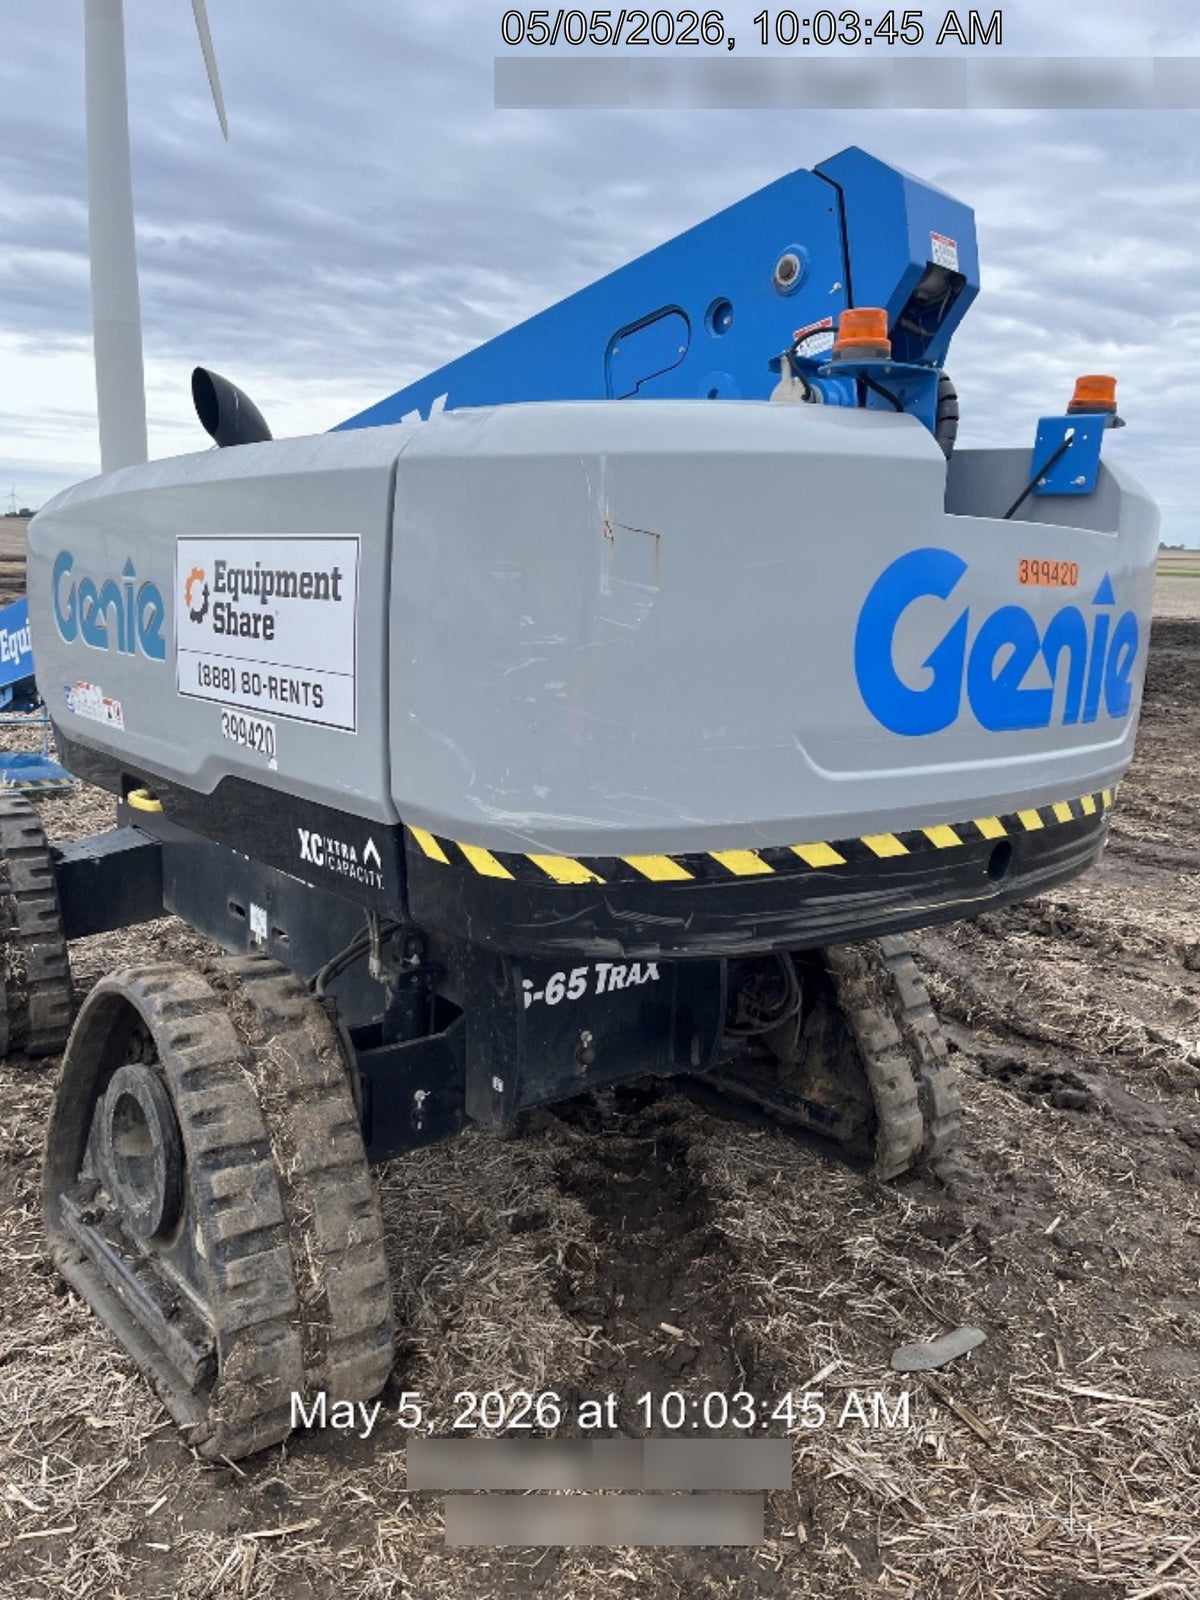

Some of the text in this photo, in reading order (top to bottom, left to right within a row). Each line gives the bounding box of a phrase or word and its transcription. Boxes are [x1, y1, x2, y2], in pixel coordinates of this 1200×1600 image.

[213, 560, 343, 605] Equipment
[1018, 559, 1079, 586] 399420
[53, 550, 167, 662] Genie
[212, 602, 275, 640] Share
[853, 546, 1139, 737] Genie
[198, 661, 324, 708] (888) 80-RENTS
[221, 711, 275, 760] 399420
[298, 827, 358, 867] XC XTRA
[594, 962, 660, 995] TRAX
